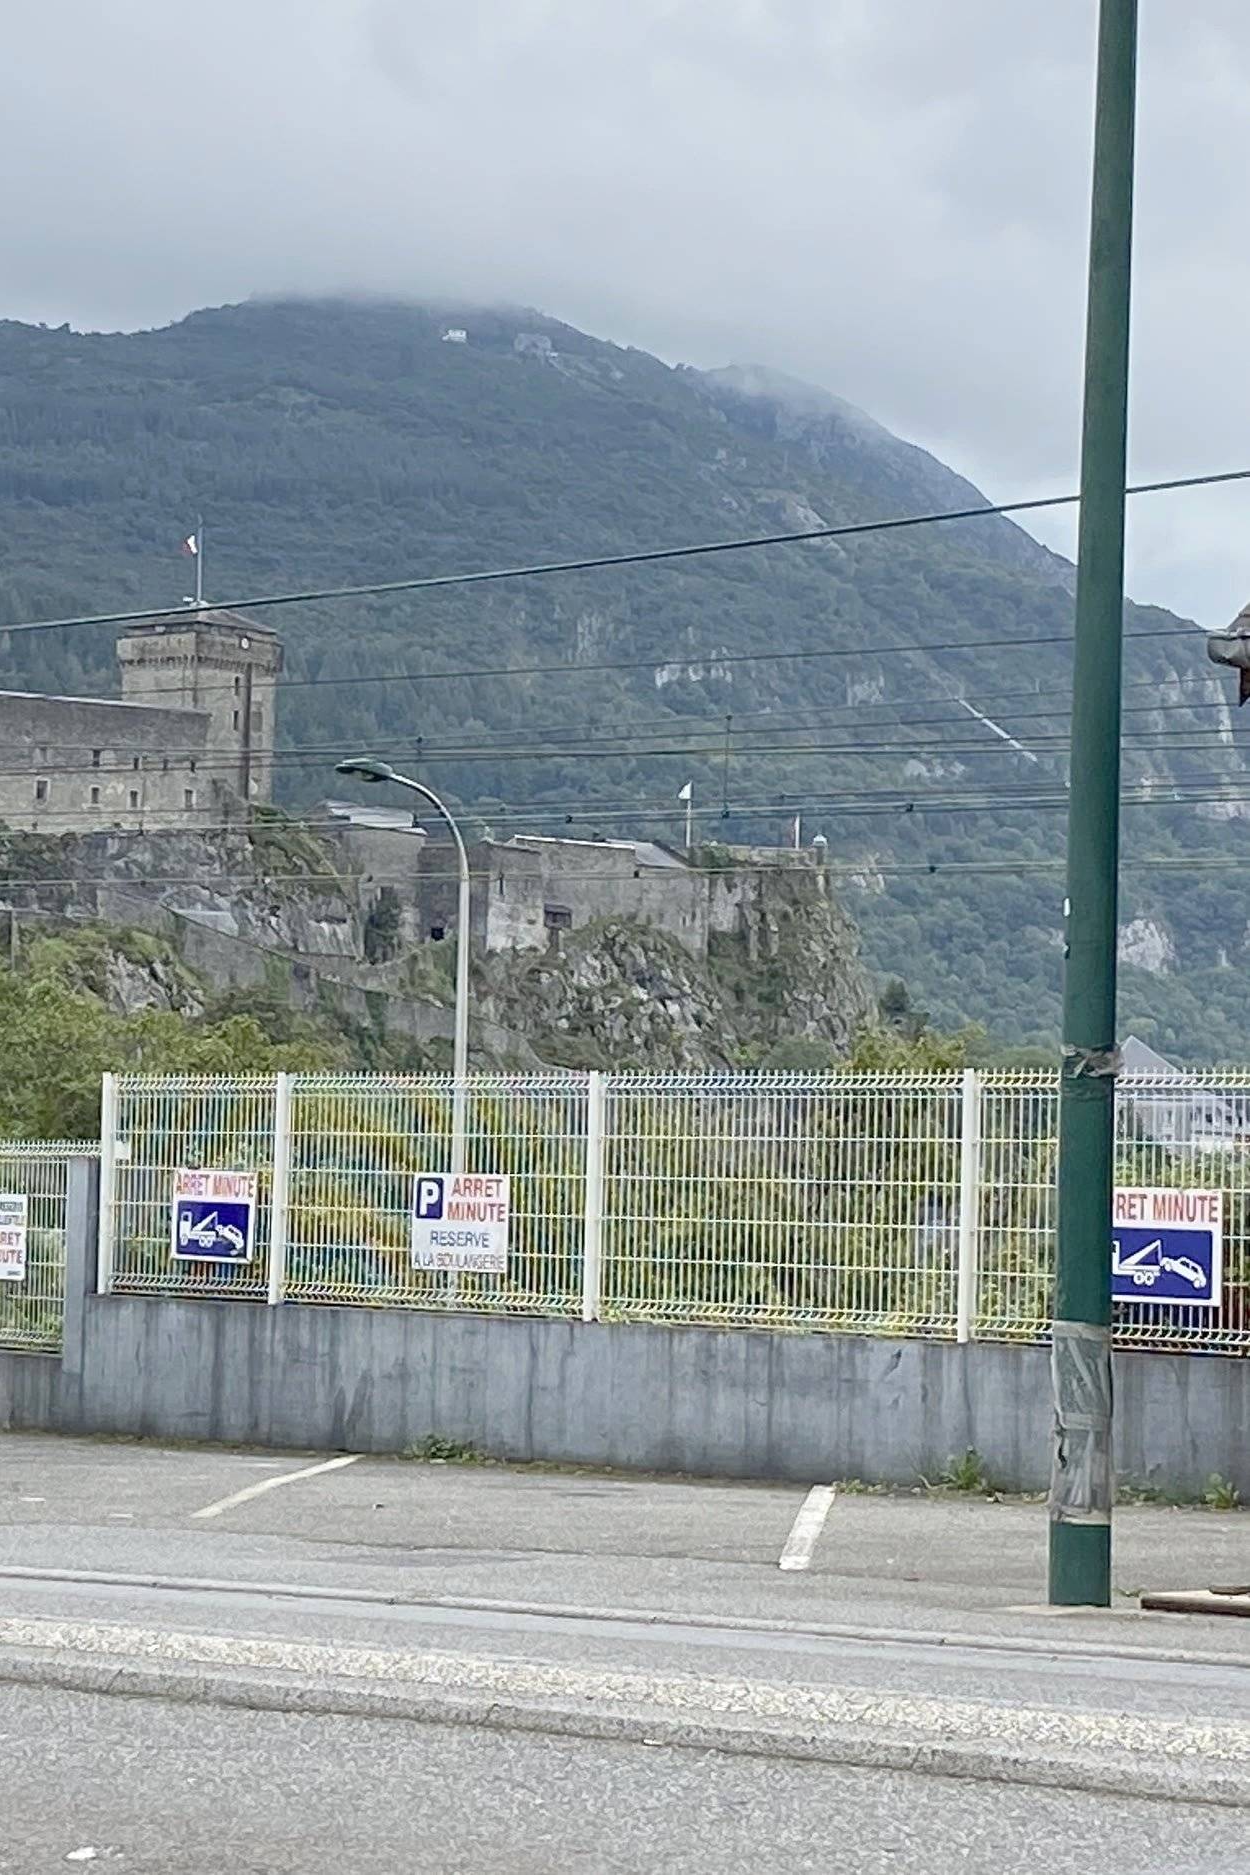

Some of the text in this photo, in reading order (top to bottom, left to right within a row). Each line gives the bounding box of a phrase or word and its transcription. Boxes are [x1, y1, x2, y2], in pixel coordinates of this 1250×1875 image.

[176, 1174, 254, 1198] ARRET MINUTE
[452, 1177, 503, 1198] ARRET
[419, 1181, 439, 1216] P
[1153, 1194, 1218, 1223] MINUTE
[448, 1202, 505, 1222] MINUTE
[430, 1230, 490, 1249] RESERVE
